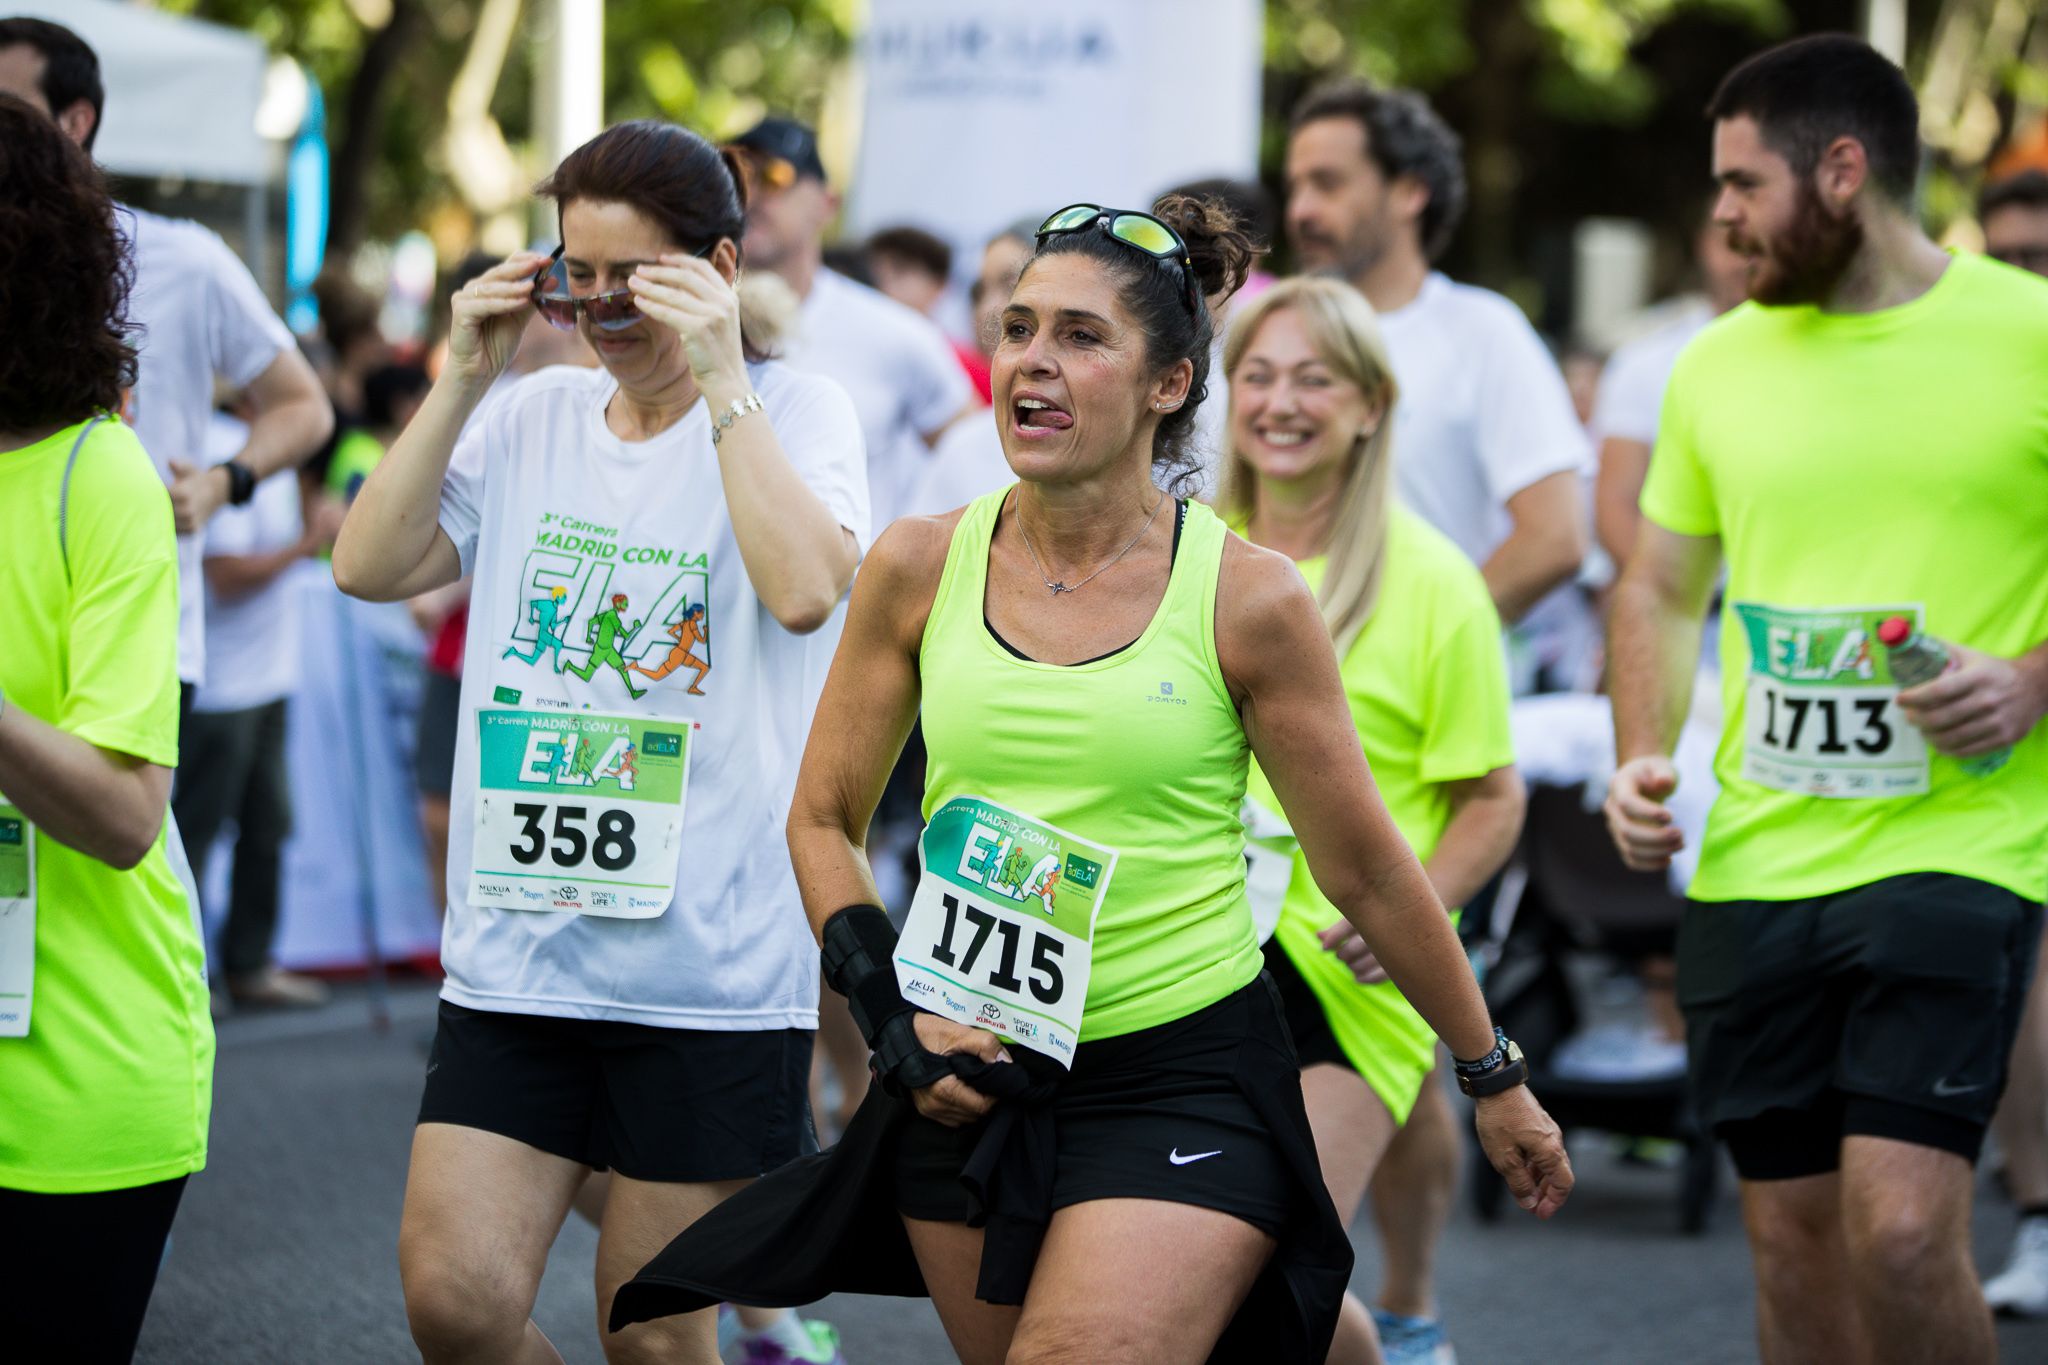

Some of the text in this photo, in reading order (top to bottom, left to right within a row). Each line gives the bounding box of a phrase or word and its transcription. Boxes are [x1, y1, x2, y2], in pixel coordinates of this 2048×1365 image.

[536, 530, 708, 569] MADRID CON LA
[1767, 627, 1874, 680] ELA
[531, 717, 580, 732] MADRID
[582, 721, 610, 734] CON
[612, 724, 631, 736] LA
[1763, 689, 1893, 757] 1713
[517, 729, 635, 791] ELA
[509, 802, 637, 872] 358
[975, 808, 1021, 835] MADRID
[1020, 828, 1049, 848] CON
[1047, 839, 1061, 854] LA
[956, 821, 1060, 917] ELA
[592, 898, 609, 906] LIFE
[931, 892, 1065, 1005] 1715
[1013, 1016, 1034, 1030] SPORT
[1015, 1024, 1031, 1037] LIFE
